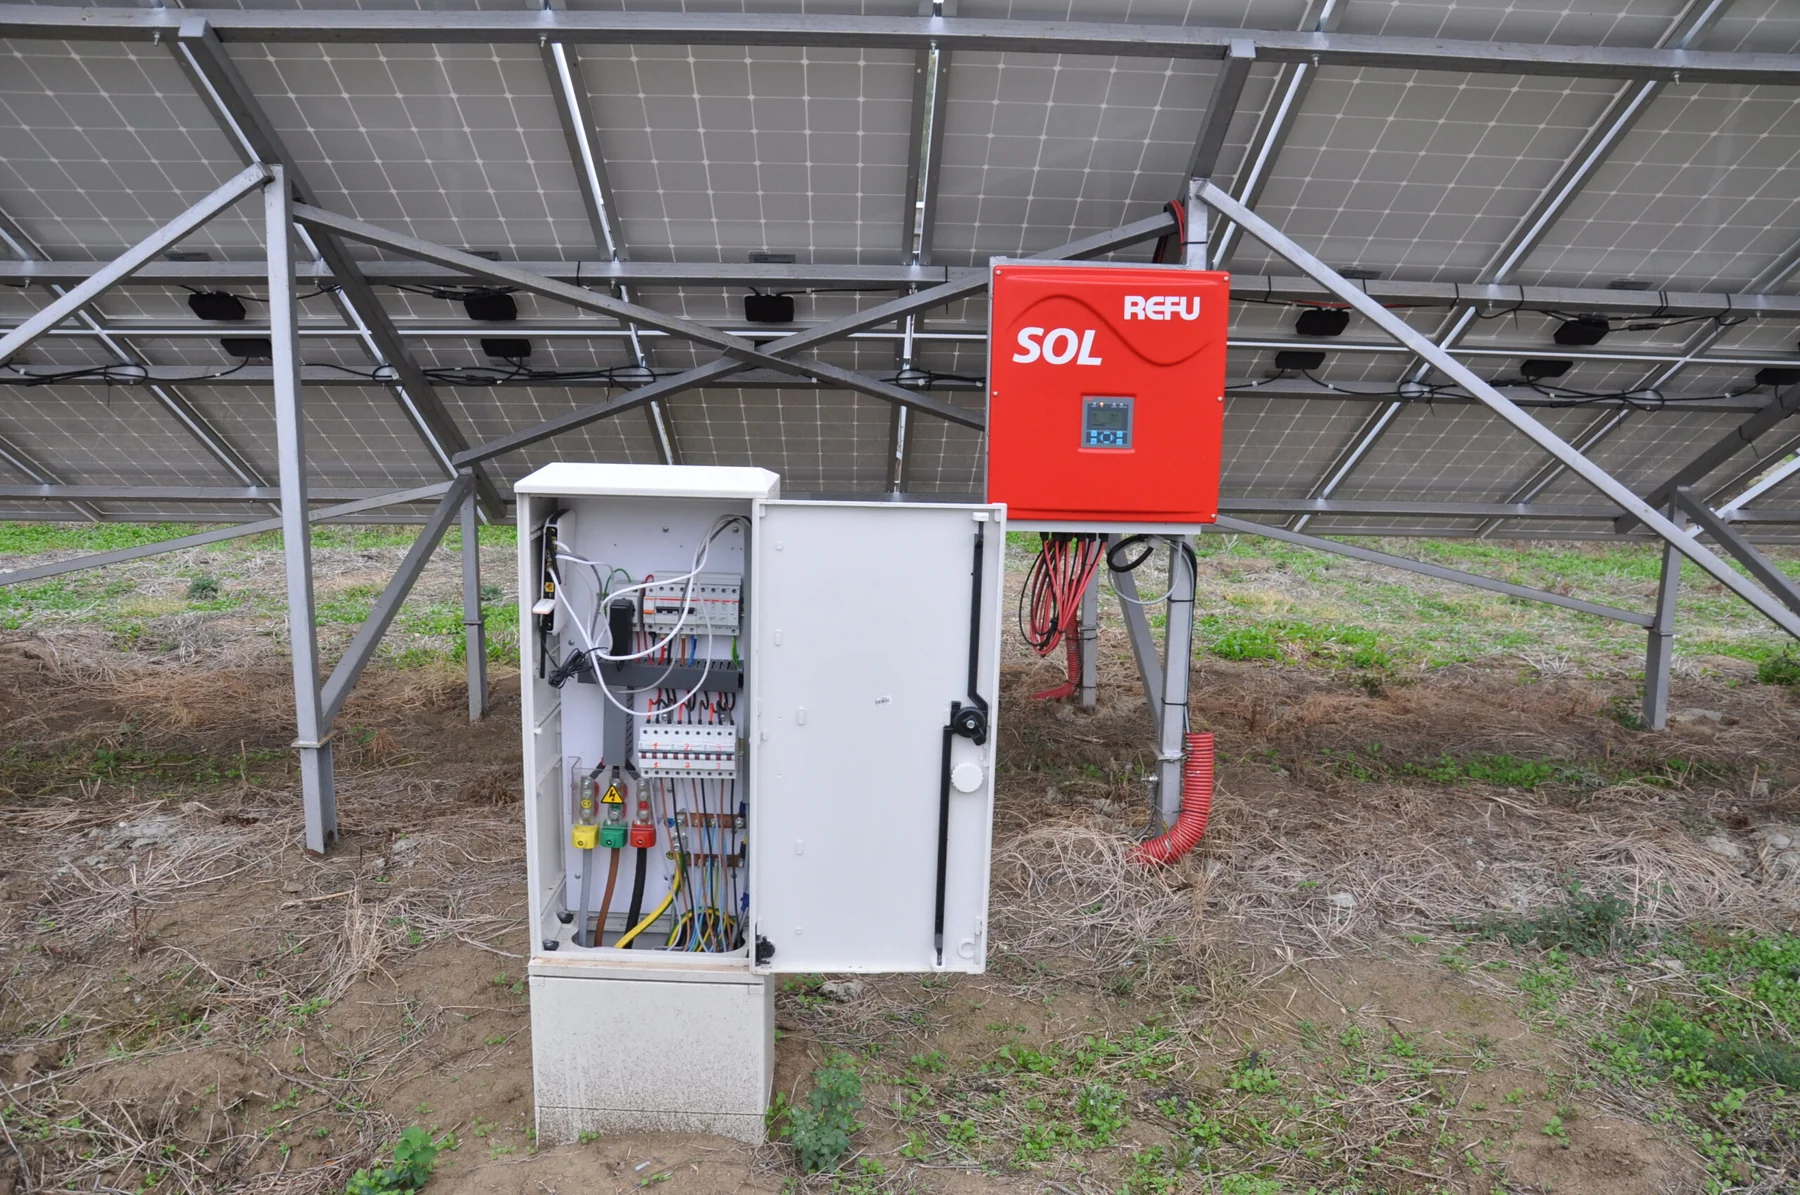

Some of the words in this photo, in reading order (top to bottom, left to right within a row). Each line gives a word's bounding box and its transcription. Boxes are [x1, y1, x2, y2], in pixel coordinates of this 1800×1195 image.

[1124, 295, 1201, 321] REFU
[1012, 326, 1103, 366] SOL
[715, 762, 721, 770] 3
